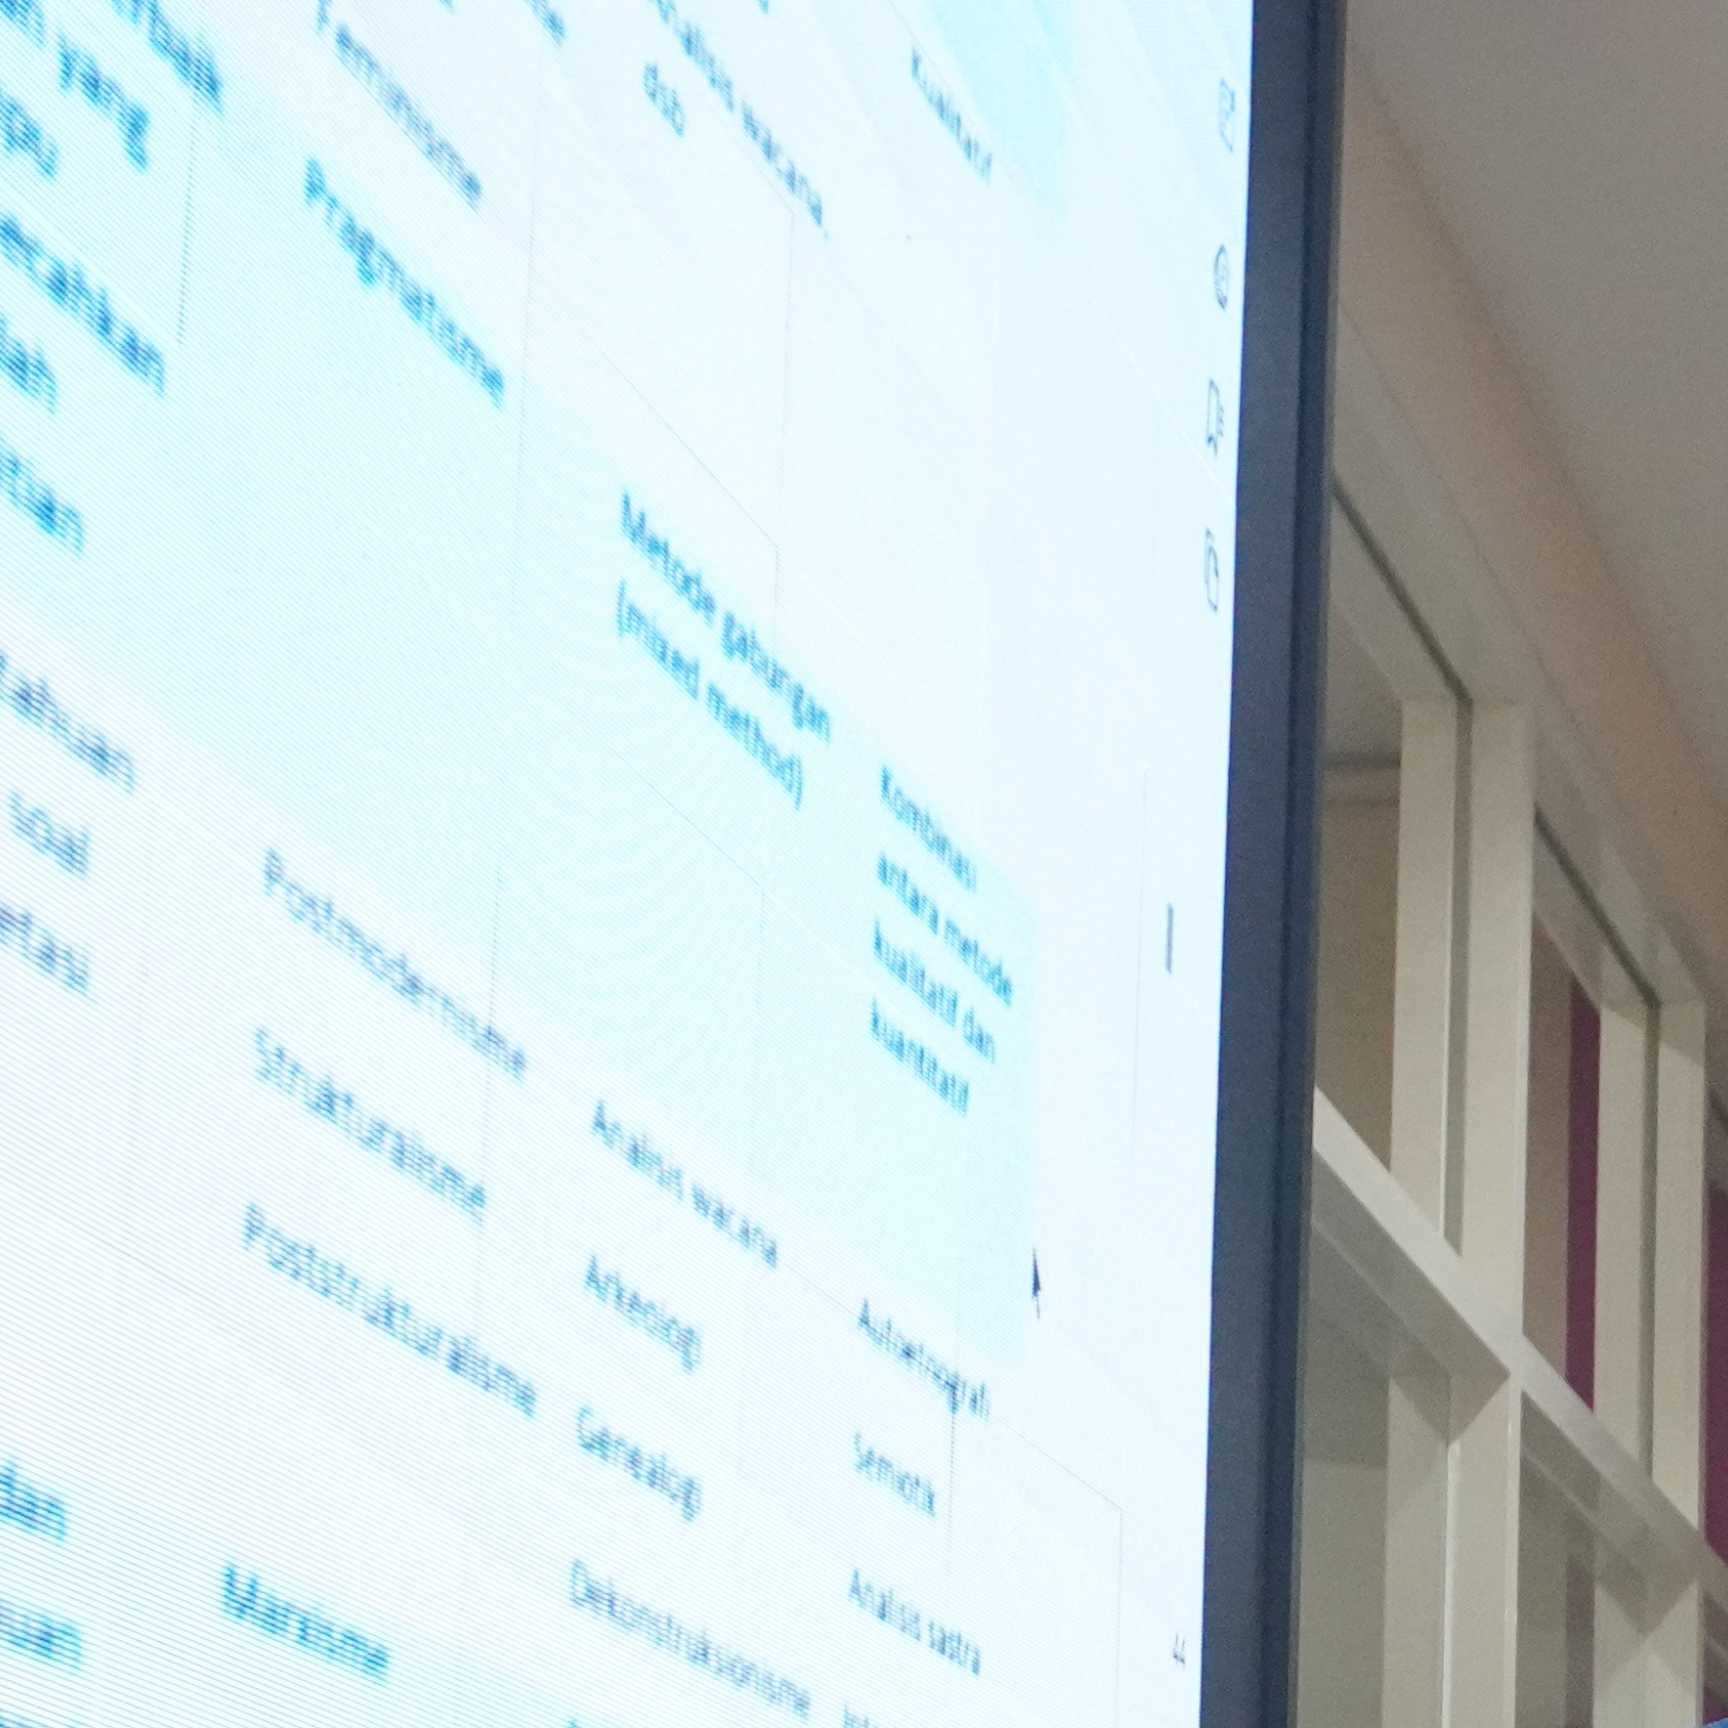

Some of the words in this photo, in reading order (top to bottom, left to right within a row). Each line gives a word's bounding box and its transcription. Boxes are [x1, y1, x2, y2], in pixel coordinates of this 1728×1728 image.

[642, 62, 684, 137] dsb
[303, 159, 504, 405] Pragmatisme
[621, 492, 716, 624] Metode
[720, 611, 830, 740] gabungan
[615, 581, 700, 700] (mixed
[705, 683, 803, 809] method)
[880, 765, 976, 890] Kombinasi
[263, 849, 526, 1080] Postmodernisme
[872, 920, 959, 1027] kualitatif
[962, 1009, 995, 1061] dan
[876, 854, 939, 934] antara
[944, 918, 1013, 1006] metode
[255, 1030, 485, 1220] Strukturalisme
[870, 1001, 969, 1113] kuantitatif
[591, 1100, 682, 1199] Analisis
[691, 1184, 777, 1268] wacana
[244, 1205, 536, 1417] Poststrukturalisme
[584, 1254, 700, 1371] Arkeologi
[857, 1301, 988, 1415] Autoetnografi
[576, 1405, 700, 1521] Genealogi
[853, 1433, 935, 1517] Semiotik
[222, 1564, 389, 1680] Marxisme
[569, 1560, 810, 1719] Dekonstruksionisme
[848, 1569, 921, 1641] Analisis
[927, 1620, 980, 1675] sastra
